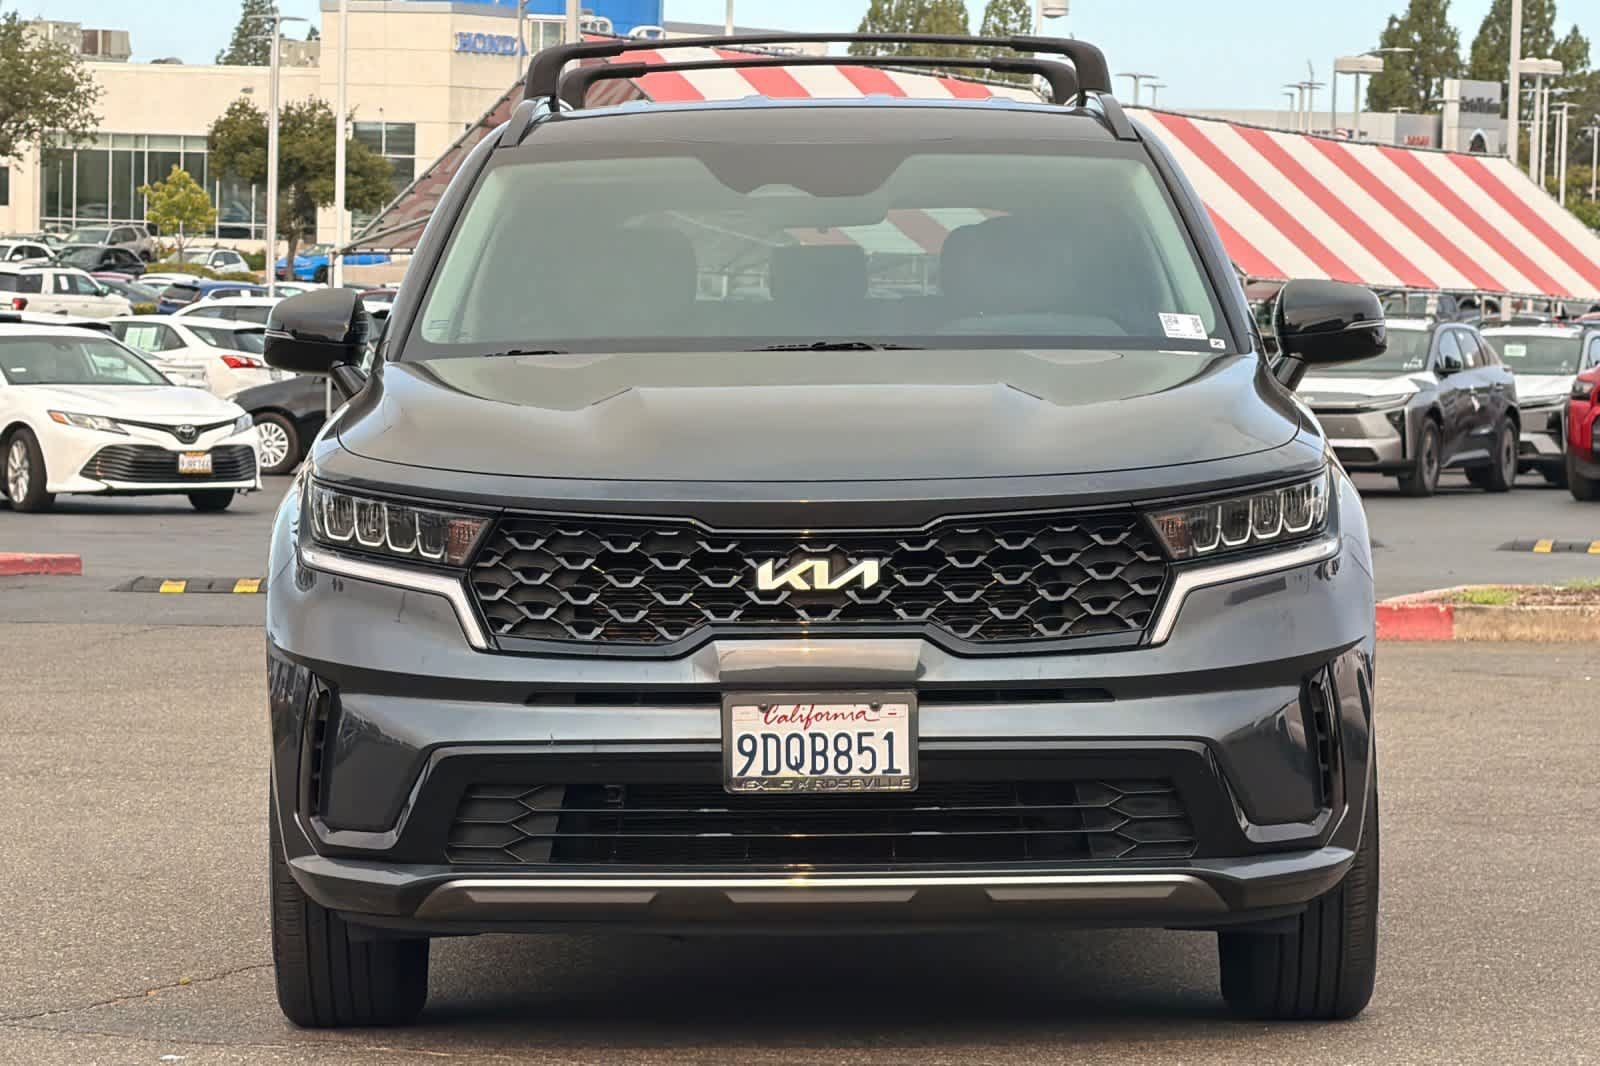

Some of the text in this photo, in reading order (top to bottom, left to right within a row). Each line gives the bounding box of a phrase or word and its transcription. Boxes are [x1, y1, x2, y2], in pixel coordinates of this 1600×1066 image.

[758, 559, 879, 590] KIA
[763, 703, 880, 730] California
[737, 731, 901, 776] 9DQB851
